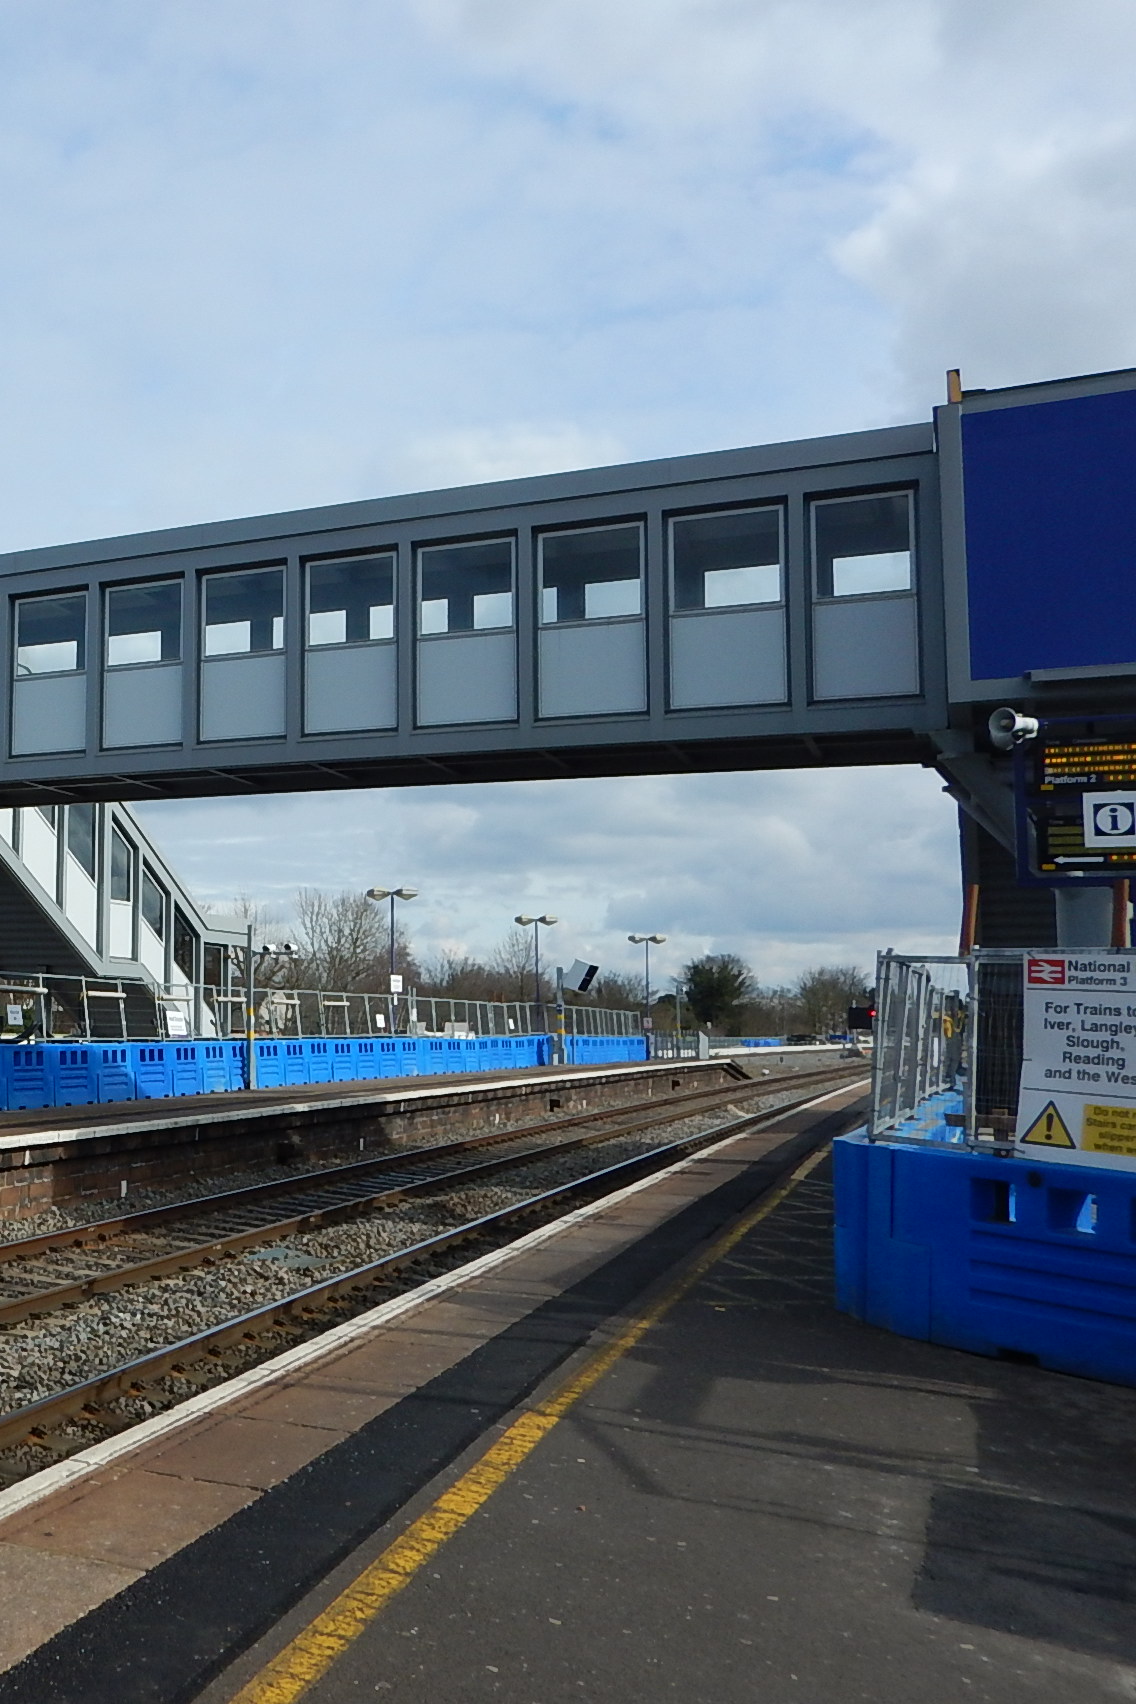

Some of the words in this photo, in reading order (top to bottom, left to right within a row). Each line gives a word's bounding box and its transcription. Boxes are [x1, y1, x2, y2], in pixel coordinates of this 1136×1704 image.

[1044, 775, 1088, 784] Platform
[1089, 774, 1097, 783] 2
[1067, 960, 1131, 973] National
[1067, 976, 1117, 986] Platform
[1119, 976, 1128, 987] 3
[1044, 1001, 1070, 1015] For
[1073, 1002, 1122, 1017] Trains
[1044, 1017, 1076, 1033] Iver,
[1065, 1034, 1126, 1053] Slough,
[1062, 1051, 1126, 1071] Reading
[1044, 1068, 1072, 1080] and
[1076, 1068, 1101, 1082] the
[1093, 1106, 1109, 1117] Do
[1111, 1110, 1130, 1119] not
[1086, 1117, 1117, 1129] Stairs
